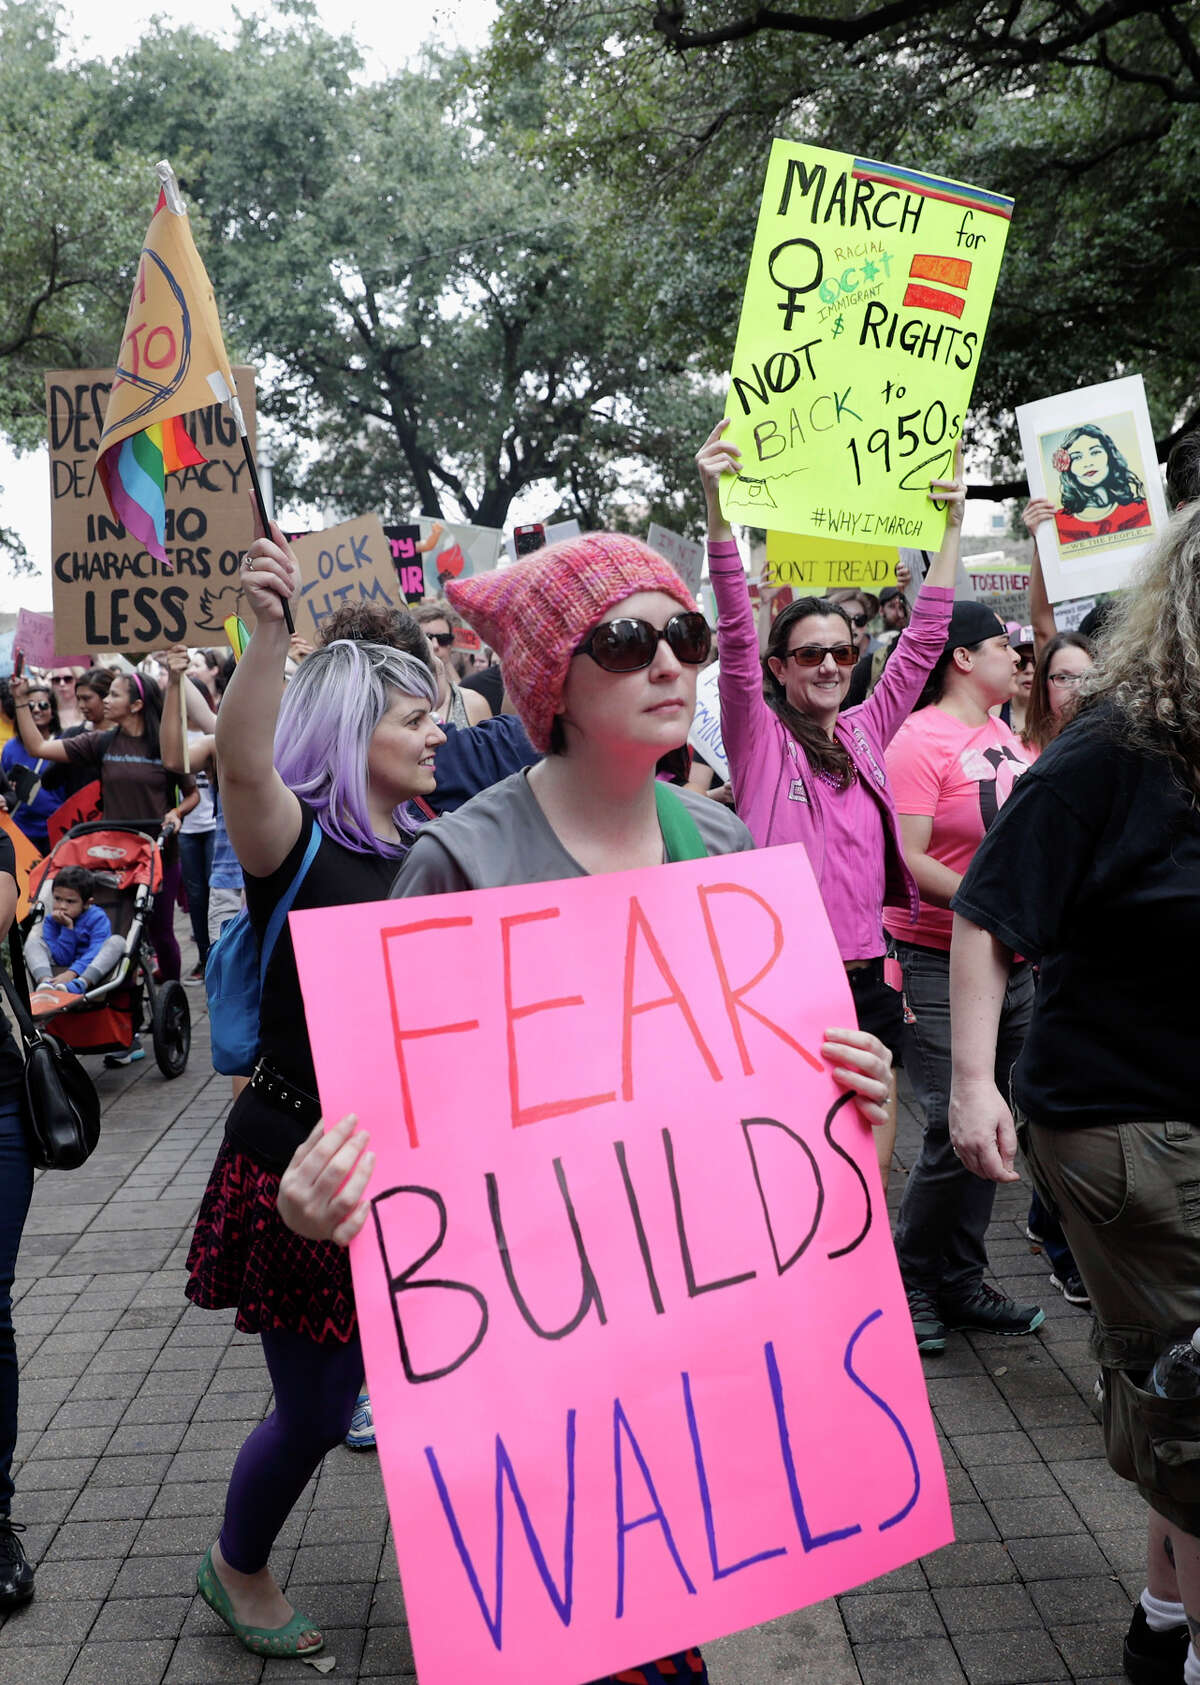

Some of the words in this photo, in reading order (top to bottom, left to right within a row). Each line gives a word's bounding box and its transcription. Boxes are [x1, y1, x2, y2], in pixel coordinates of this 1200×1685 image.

[777, 160, 925, 234] MARCH
[956, 211, 986, 249] for
[834, 240, 885, 262] RACIAL
[817, 282, 883, 324] IMMIGRANT
[859, 301, 978, 370] RIGHTS
[753, 386, 864, 462] BACK
[881, 380, 906, 404] to
[847, 400, 960, 486] 1950s
[87, 514, 126, 542] IN
[824, 560, 888, 582] TREAD
[85, 586, 189, 646] LESS
[380, 882, 825, 1149] FEAR
[371, 1091, 872, 1384] BUILDS
[424, 1308, 921, 1651] WALLS
